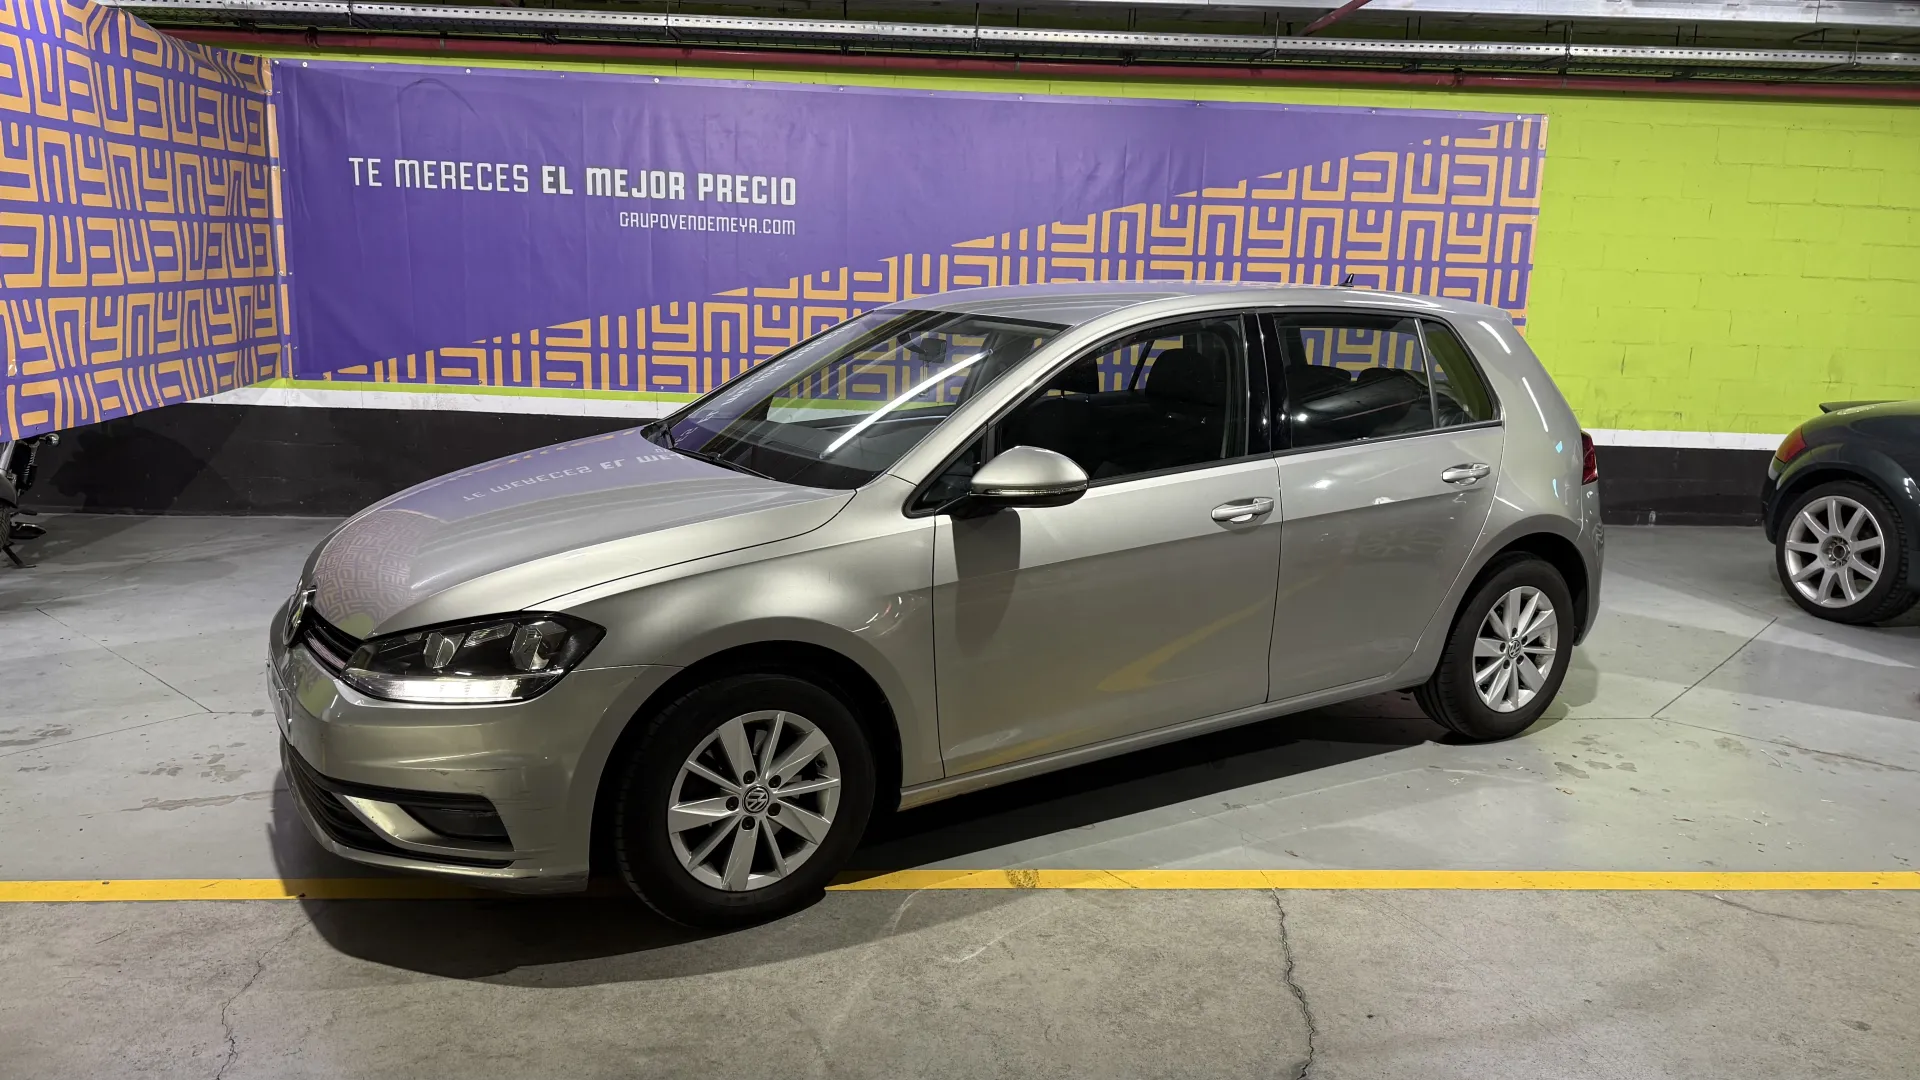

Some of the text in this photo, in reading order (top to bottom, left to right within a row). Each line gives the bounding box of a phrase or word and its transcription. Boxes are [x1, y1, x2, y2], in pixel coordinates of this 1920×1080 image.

[348, 157, 797, 206] TE MERECES EL MEJOR PRECIO
[619, 211, 797, 236] GRUPOVENDEMEYA.COM
[744, 786, 770, 813] VW
